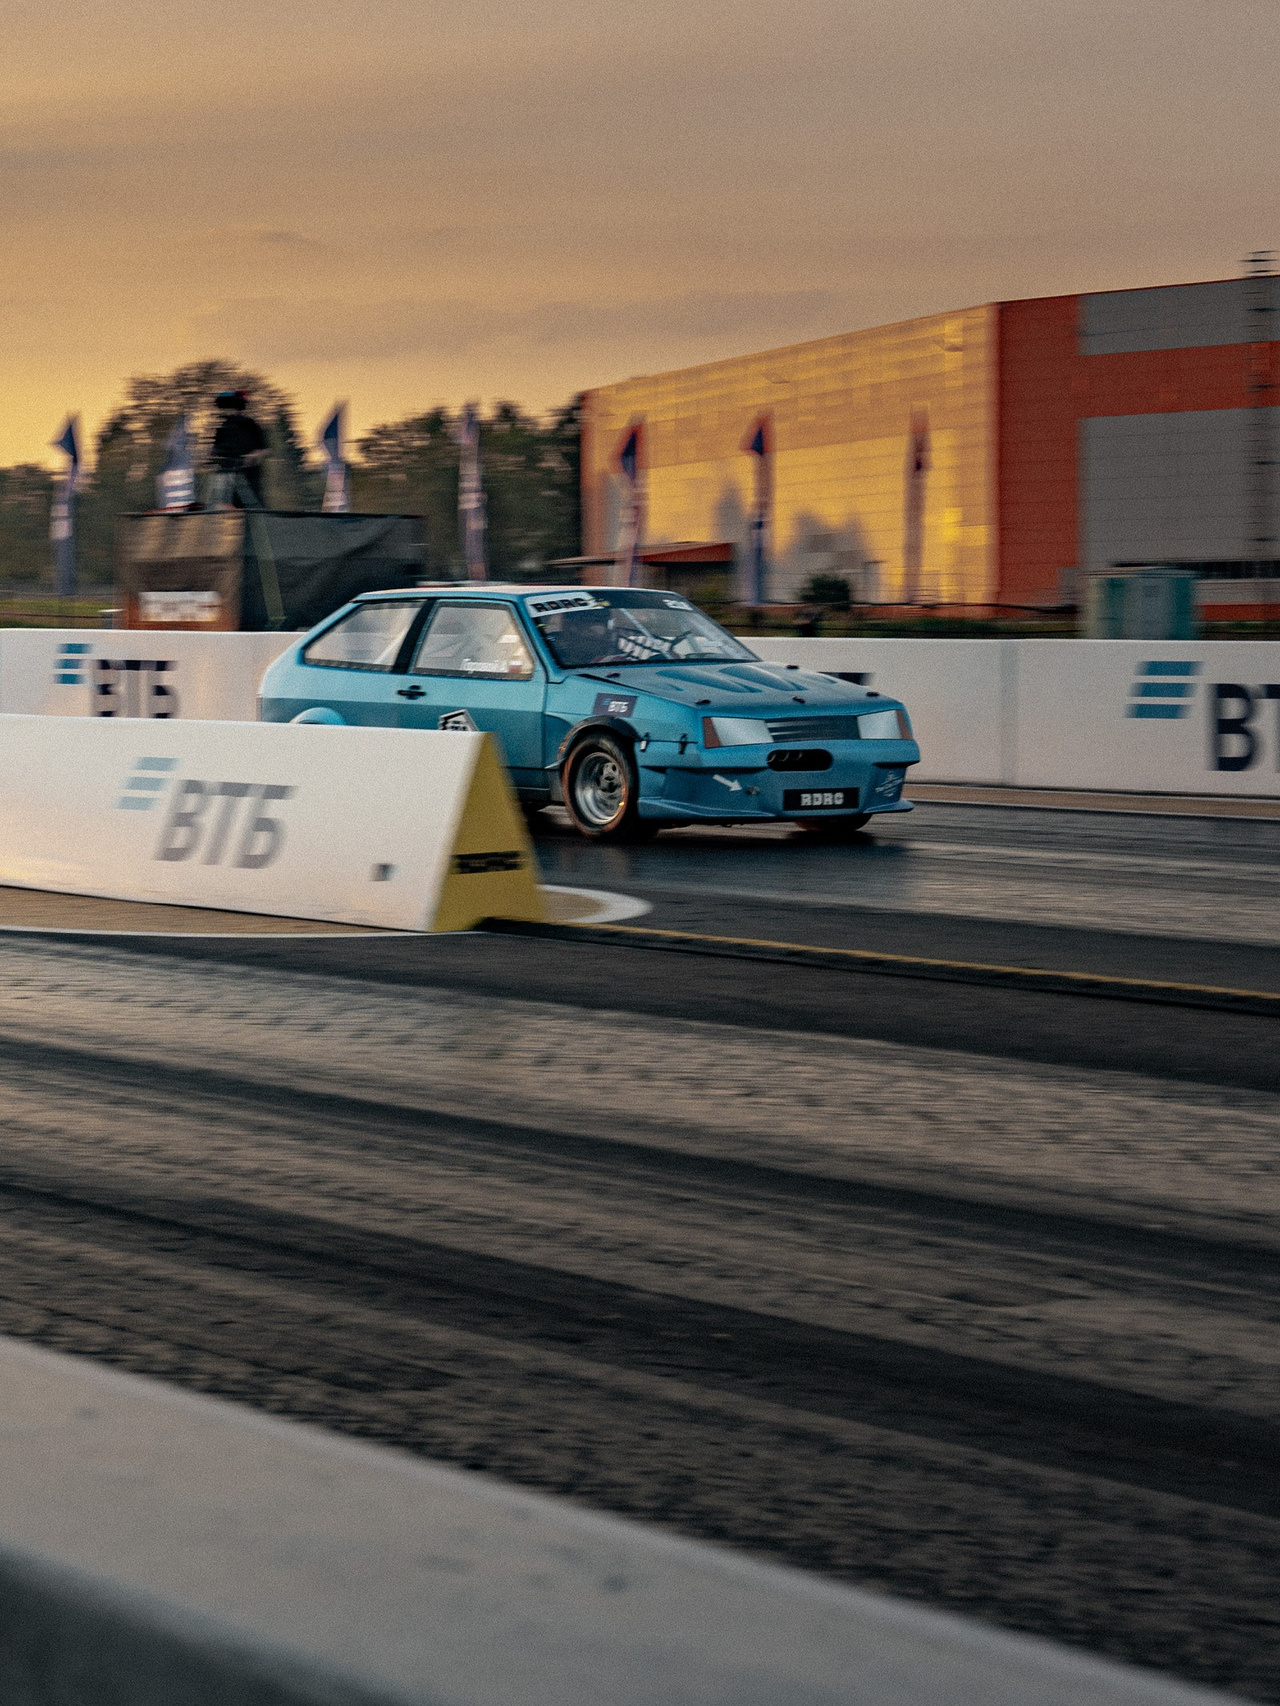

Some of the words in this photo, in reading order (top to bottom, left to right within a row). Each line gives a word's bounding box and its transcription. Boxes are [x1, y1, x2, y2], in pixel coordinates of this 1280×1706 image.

[531, 597, 588, 613] RDRC
[801, 792, 845, 807] RDRC
[154, 779, 298, 870] ВТБ
